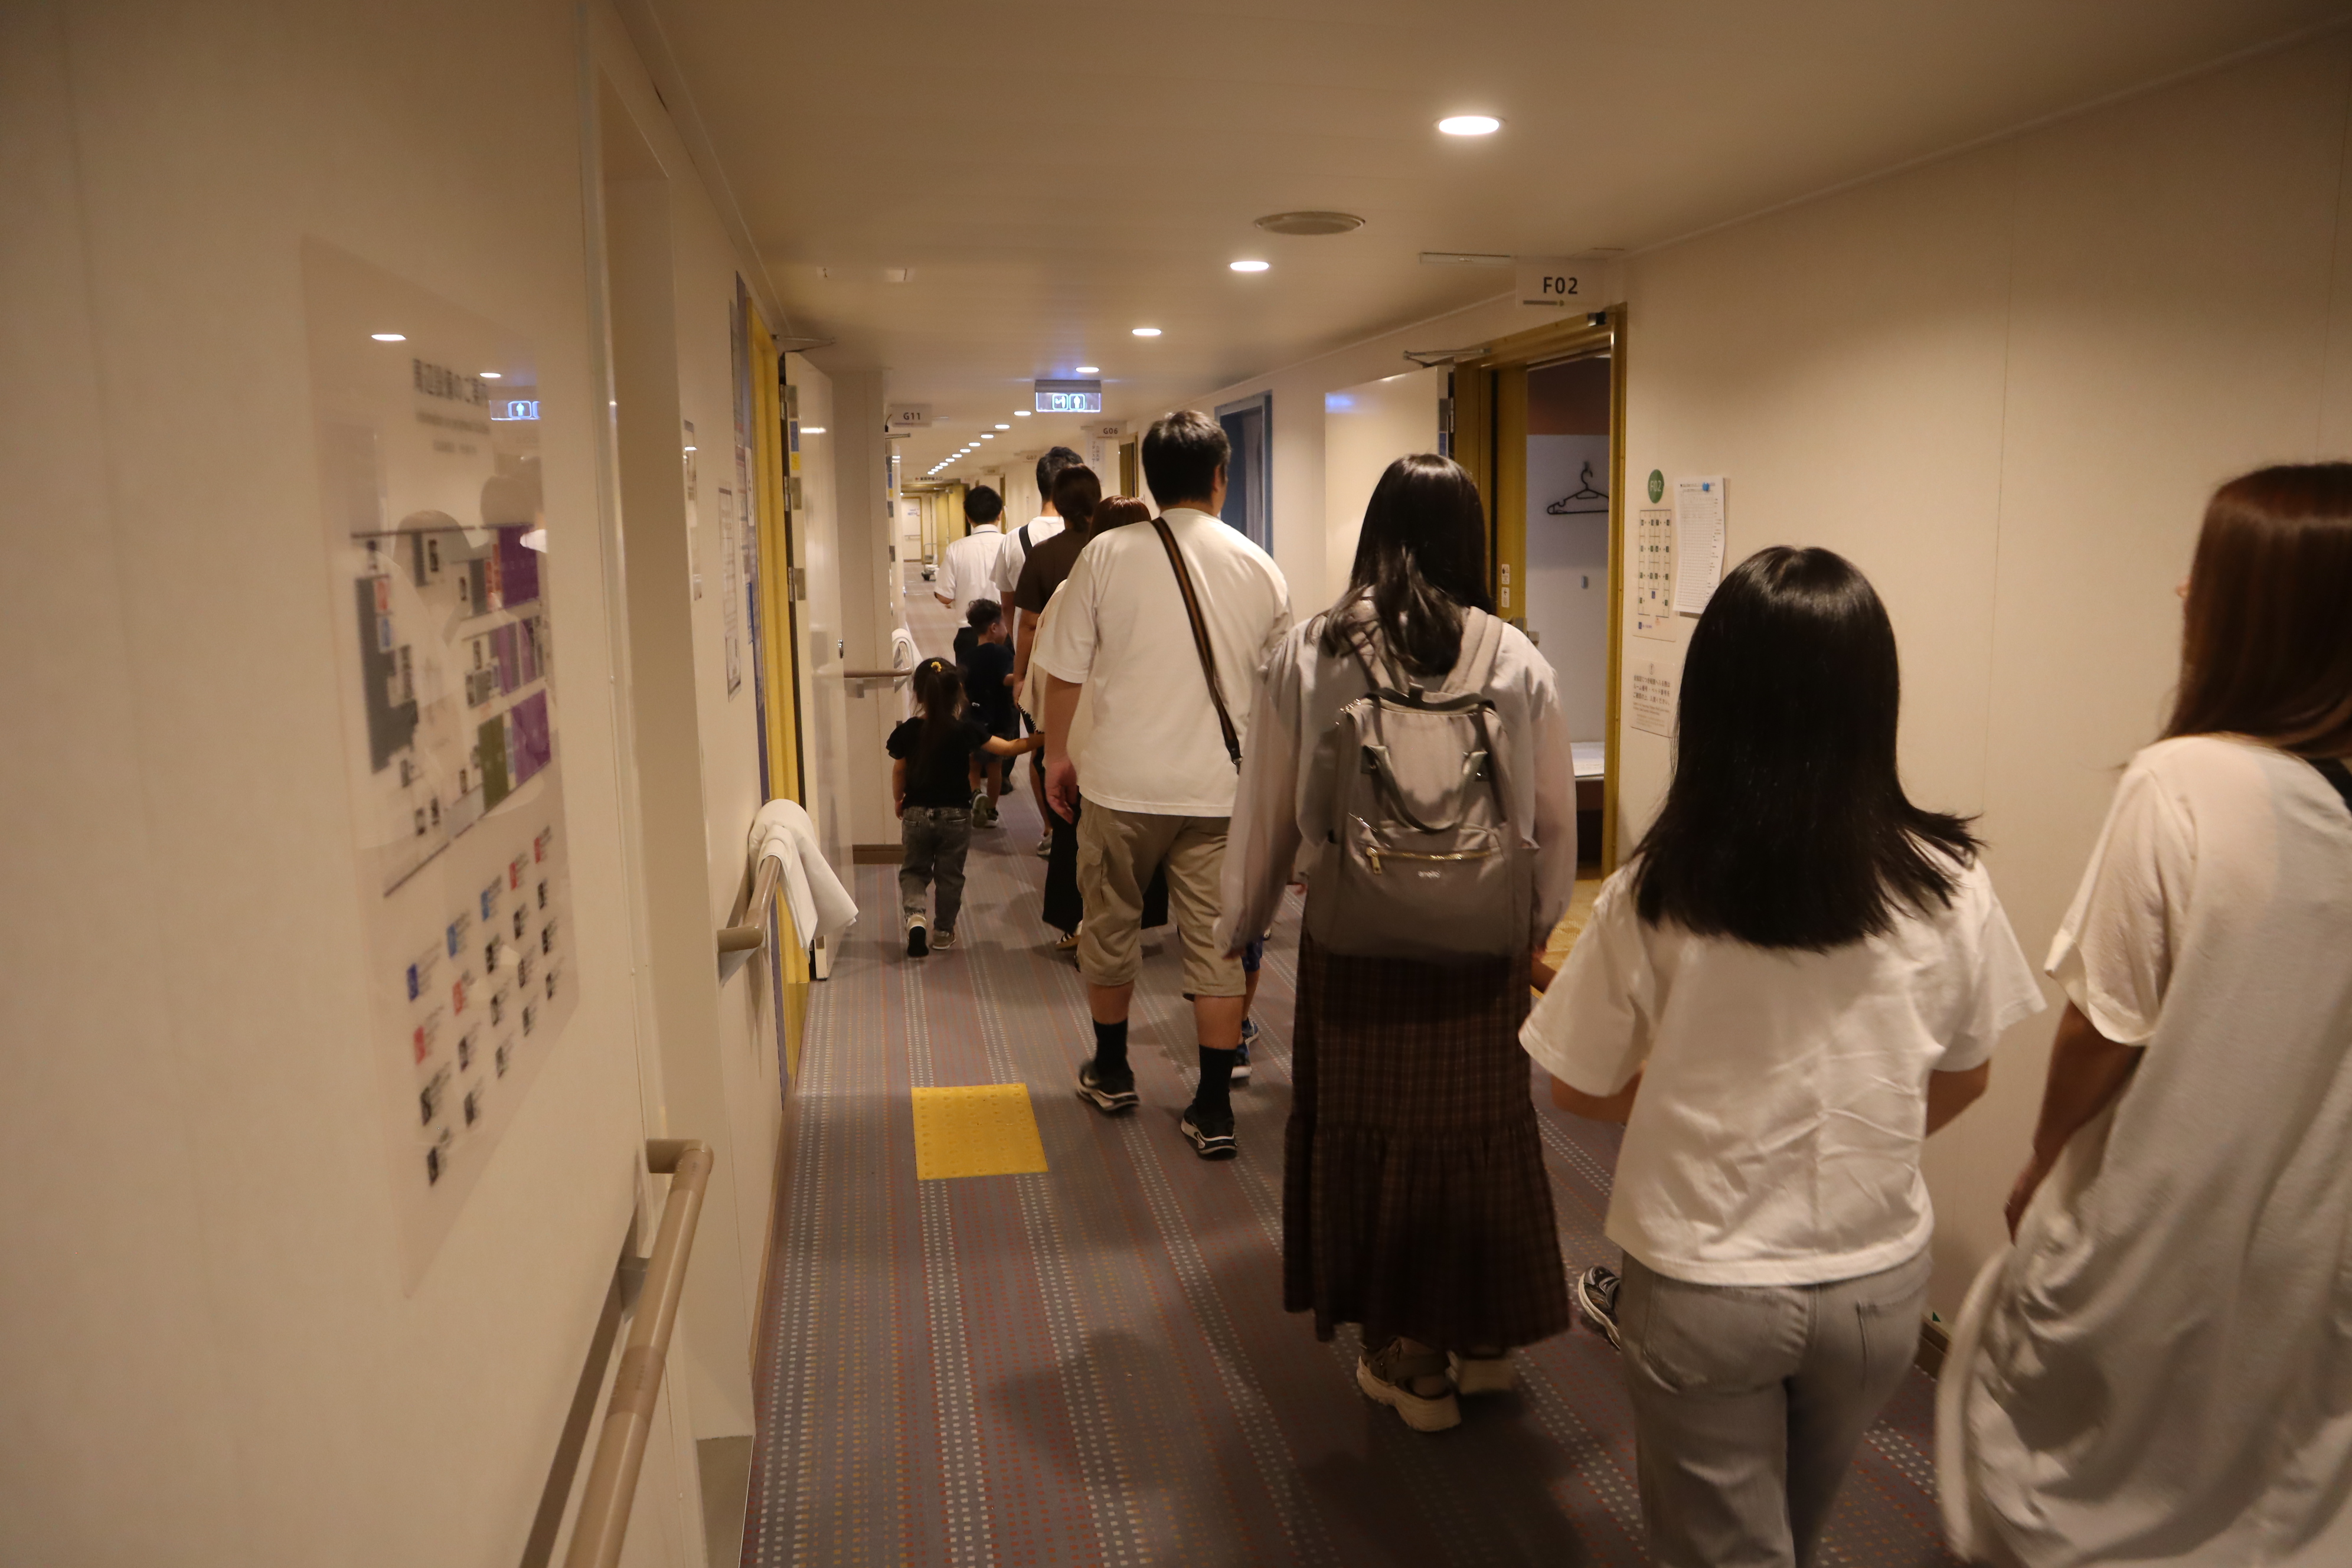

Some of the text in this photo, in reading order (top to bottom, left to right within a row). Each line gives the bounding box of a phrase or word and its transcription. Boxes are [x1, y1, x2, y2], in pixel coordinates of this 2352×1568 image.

[1543, 276, 1578, 295] F02
[903, 412, 920, 420] G11
[1650, 479, 1662, 492] F02
